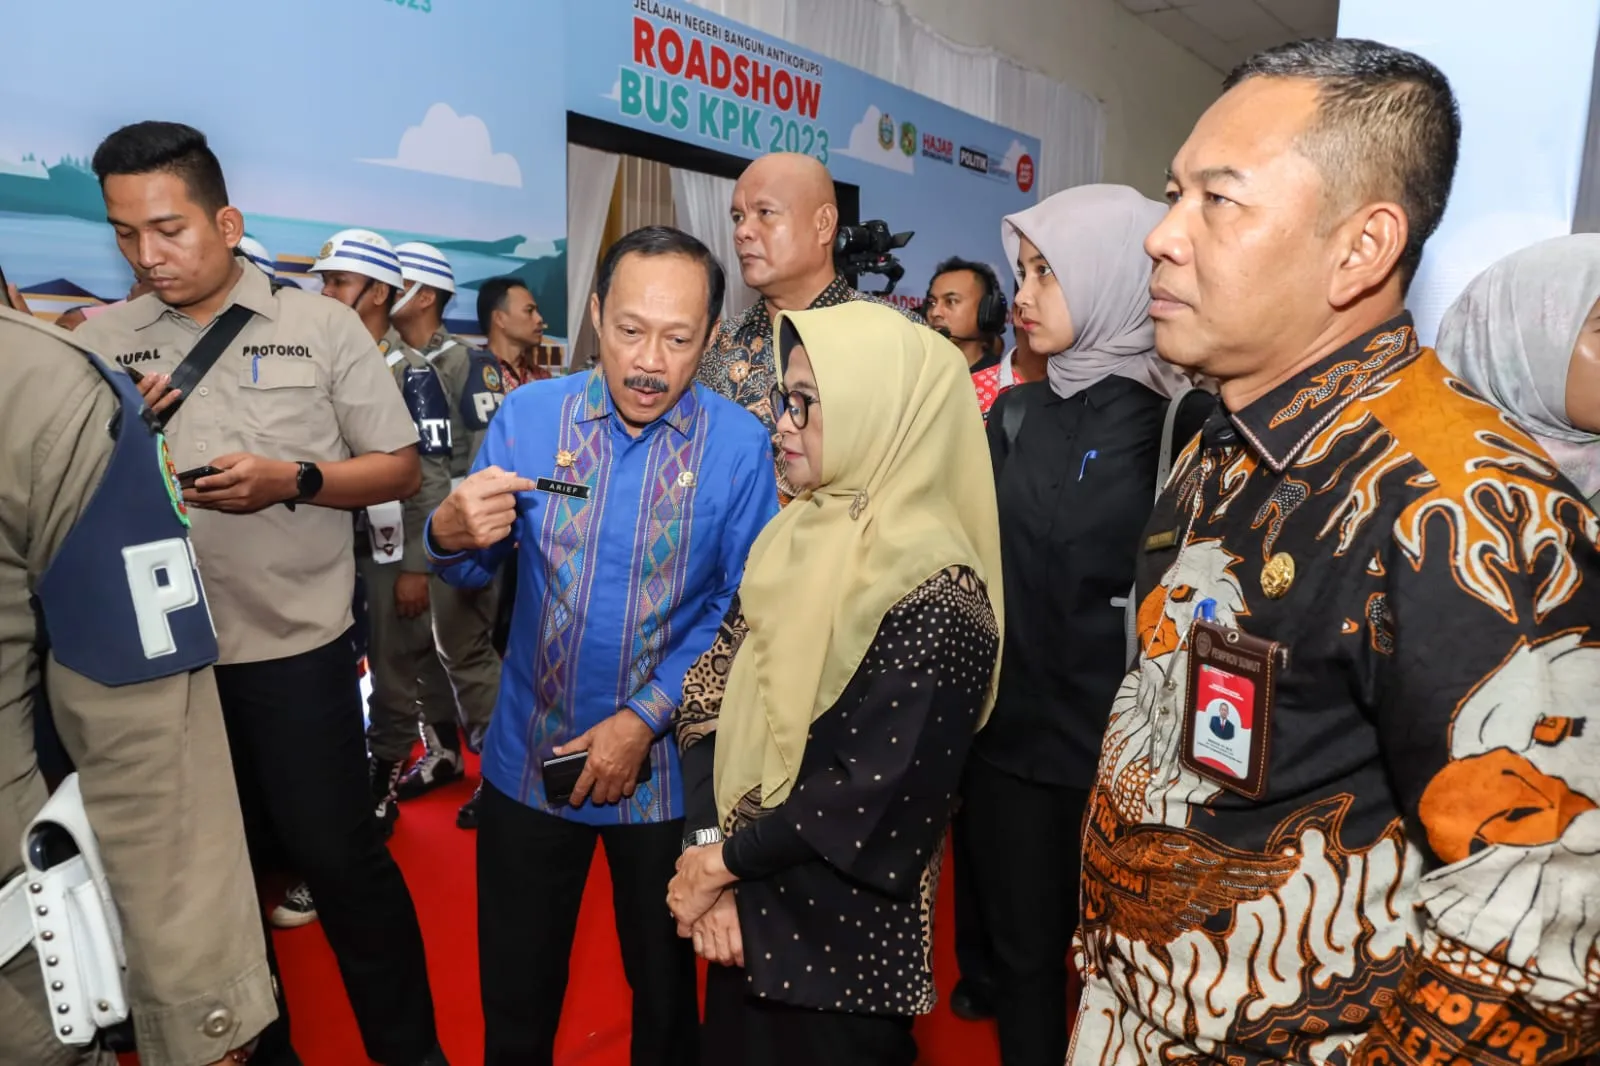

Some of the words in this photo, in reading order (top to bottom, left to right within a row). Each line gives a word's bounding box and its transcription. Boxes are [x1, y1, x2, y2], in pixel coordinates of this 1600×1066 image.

[634, 0, 681, 24] JELAJAH
[684, 14, 722, 40] NEGERI
[724, 30, 765, 56] BANGUN
[766, 47, 823, 76] ANTIKORUPSI
[633, 16, 821, 119] ROADSHOW
[620, 68, 689, 130] BUS
[699, 92, 762, 150] KPK
[769, 115, 830, 166] 2023
[960, 150, 988, 170] POLITIK
[242, 344, 313, 358] PROTOKOL
[549, 483, 579, 494] ARIEF
